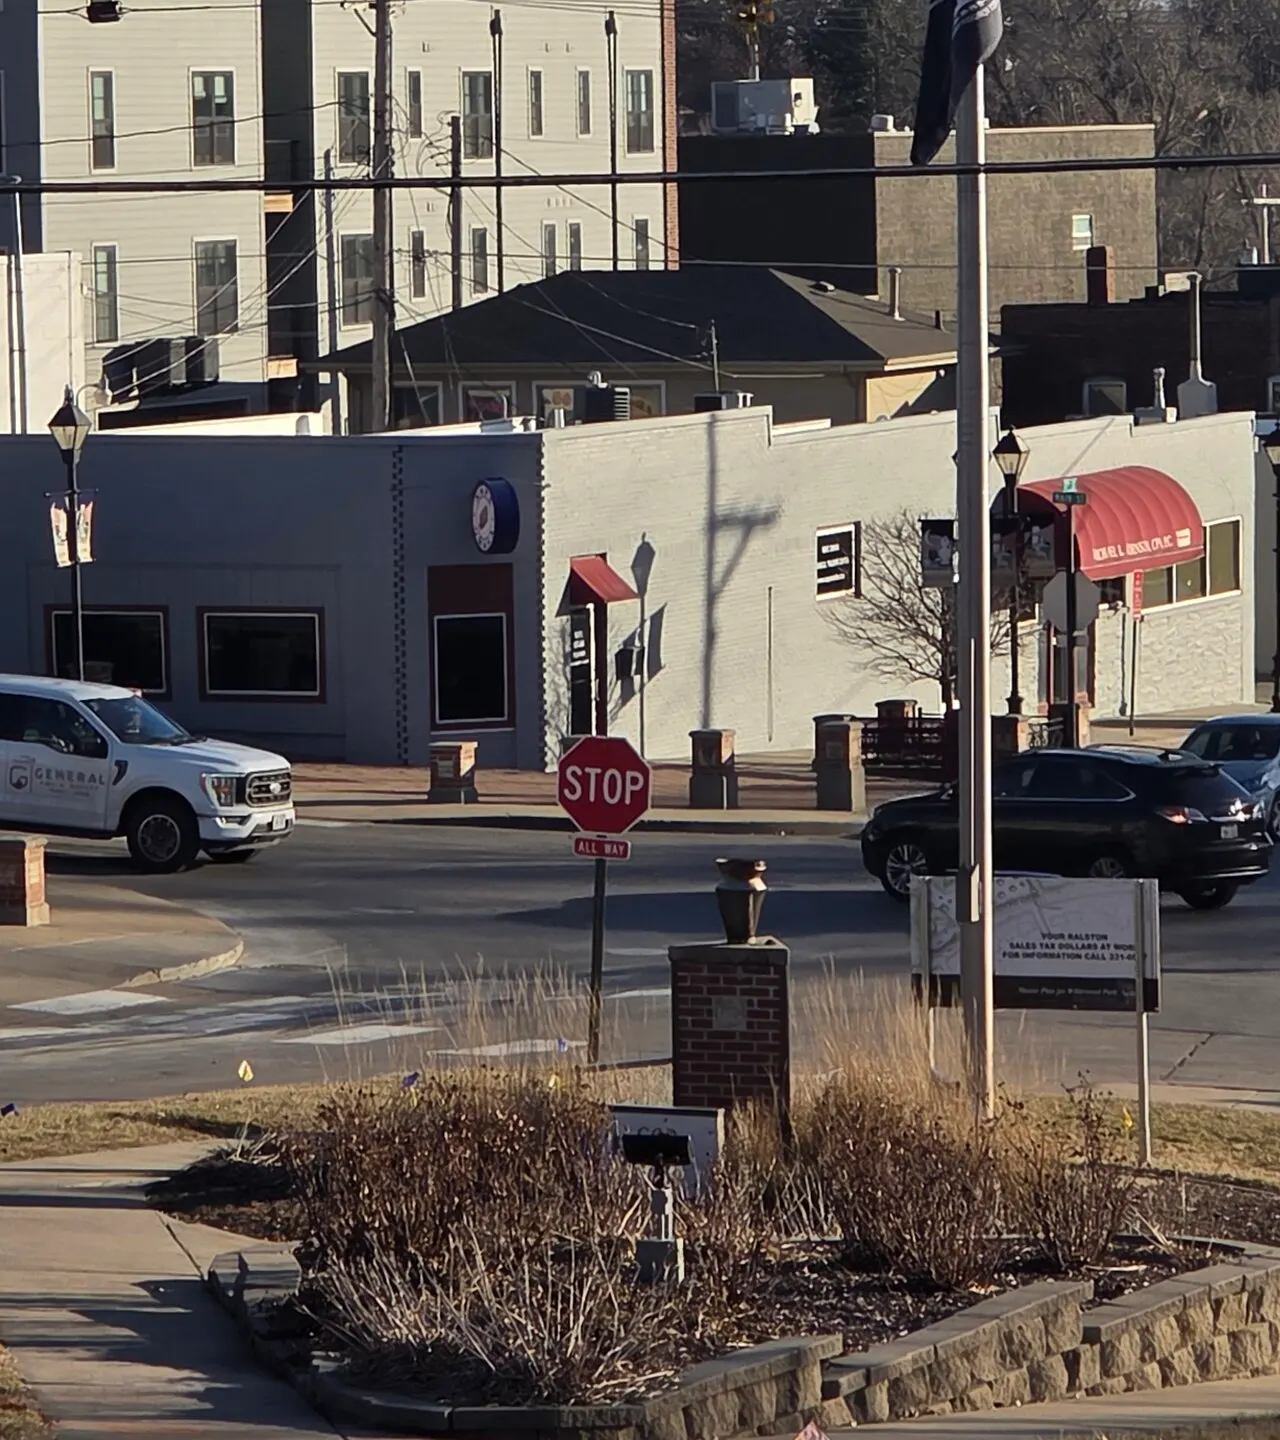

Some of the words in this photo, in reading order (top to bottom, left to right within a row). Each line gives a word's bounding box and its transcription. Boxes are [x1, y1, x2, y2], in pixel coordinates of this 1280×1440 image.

[35, 767, 105, 785] GENERAL
[563, 765, 644, 805] STOP
[578, 841, 598, 854] ALL
[604, 843, 625, 855] WAY
[1041, 932, 1065, 940] YOUR
[1067, 932, 1108, 940] RALSTON
[1009, 942, 1037, 950] SALES
[1039, 942, 1055, 950] TAX
[1058, 942, 1099, 950] DOLLARS
[1100, 943, 1111, 951] AT
[1002, 951, 1020, 959] FOR
[1022, 951, 1082, 960] INFORMATION
[1084, 952, 1107, 961] CALL
